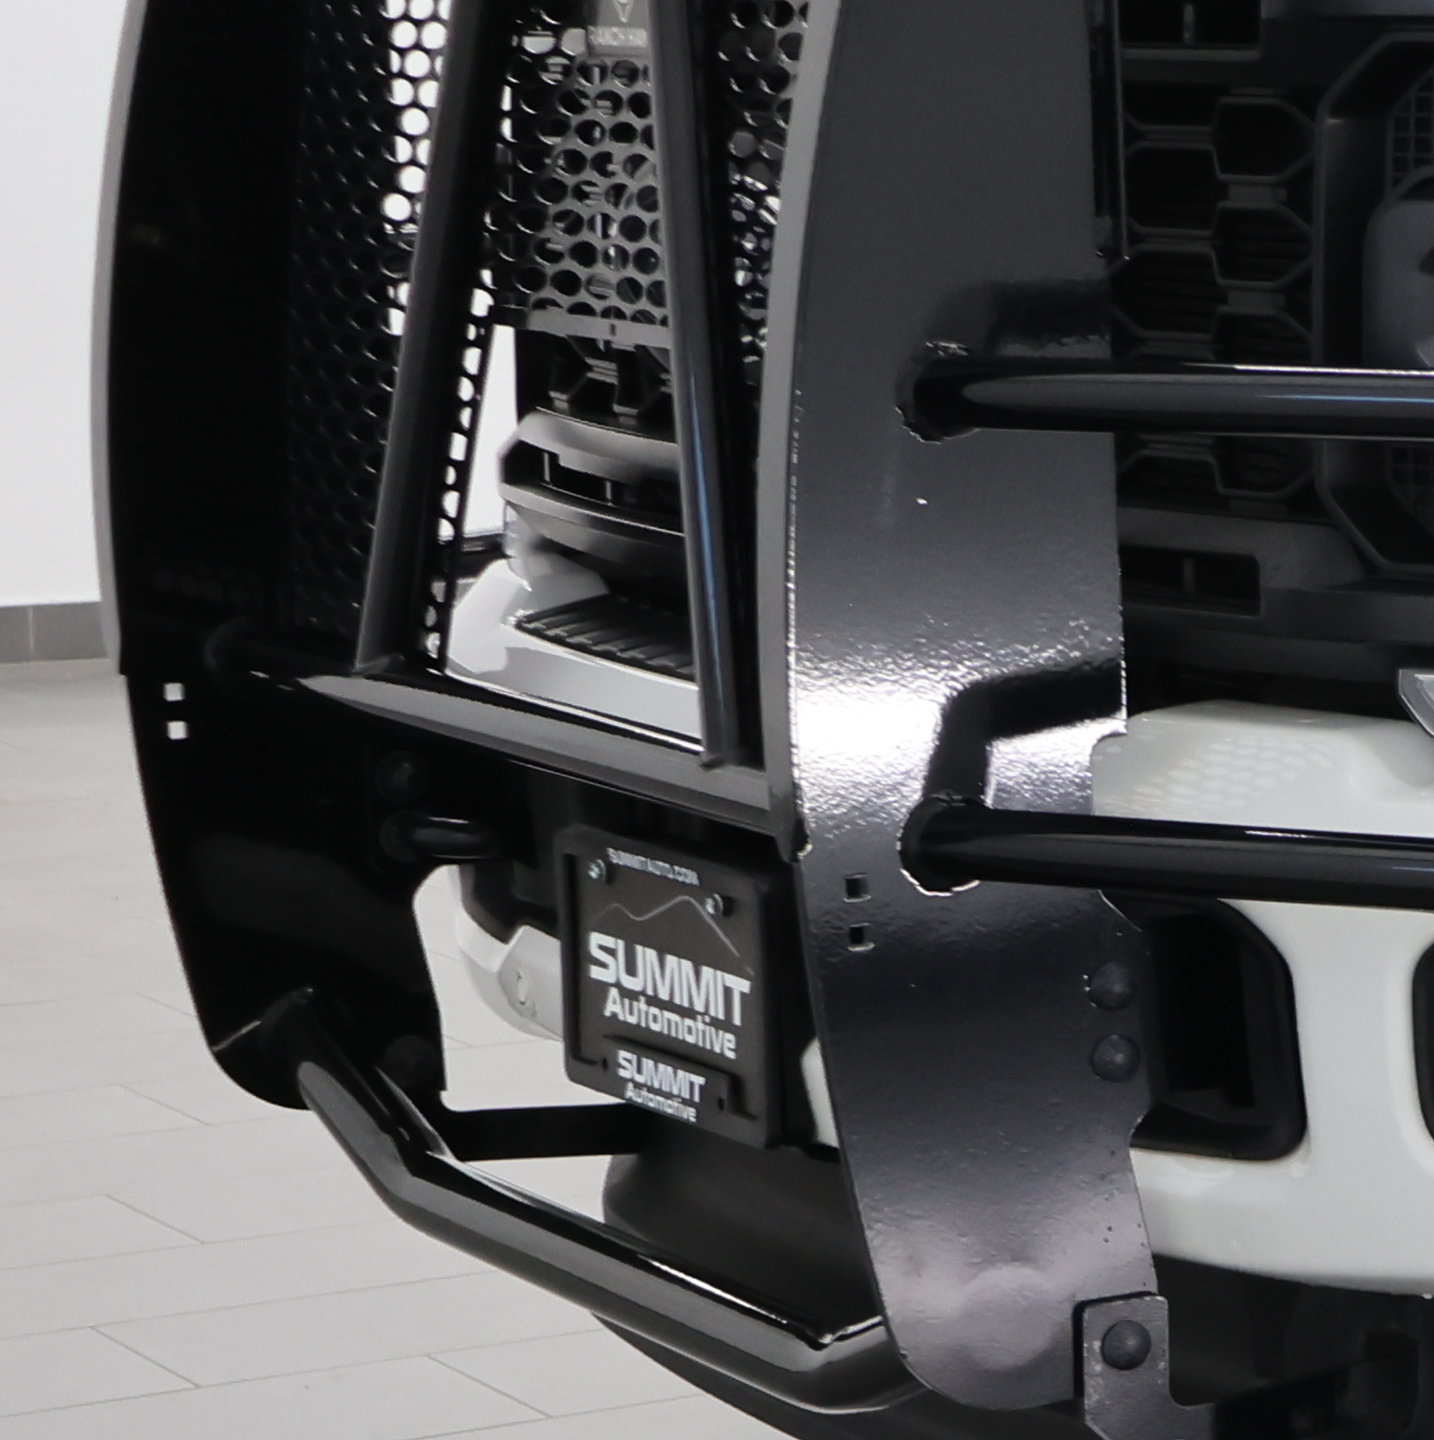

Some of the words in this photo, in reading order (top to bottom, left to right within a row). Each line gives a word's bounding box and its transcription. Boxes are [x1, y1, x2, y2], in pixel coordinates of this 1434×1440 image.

[588, 931, 752, 1027] SUMMIT
[603, 987, 737, 1060] Automotive
[617, 1049, 707, 1103] SUMMIT
[624, 1081, 698, 1123] Automotive
